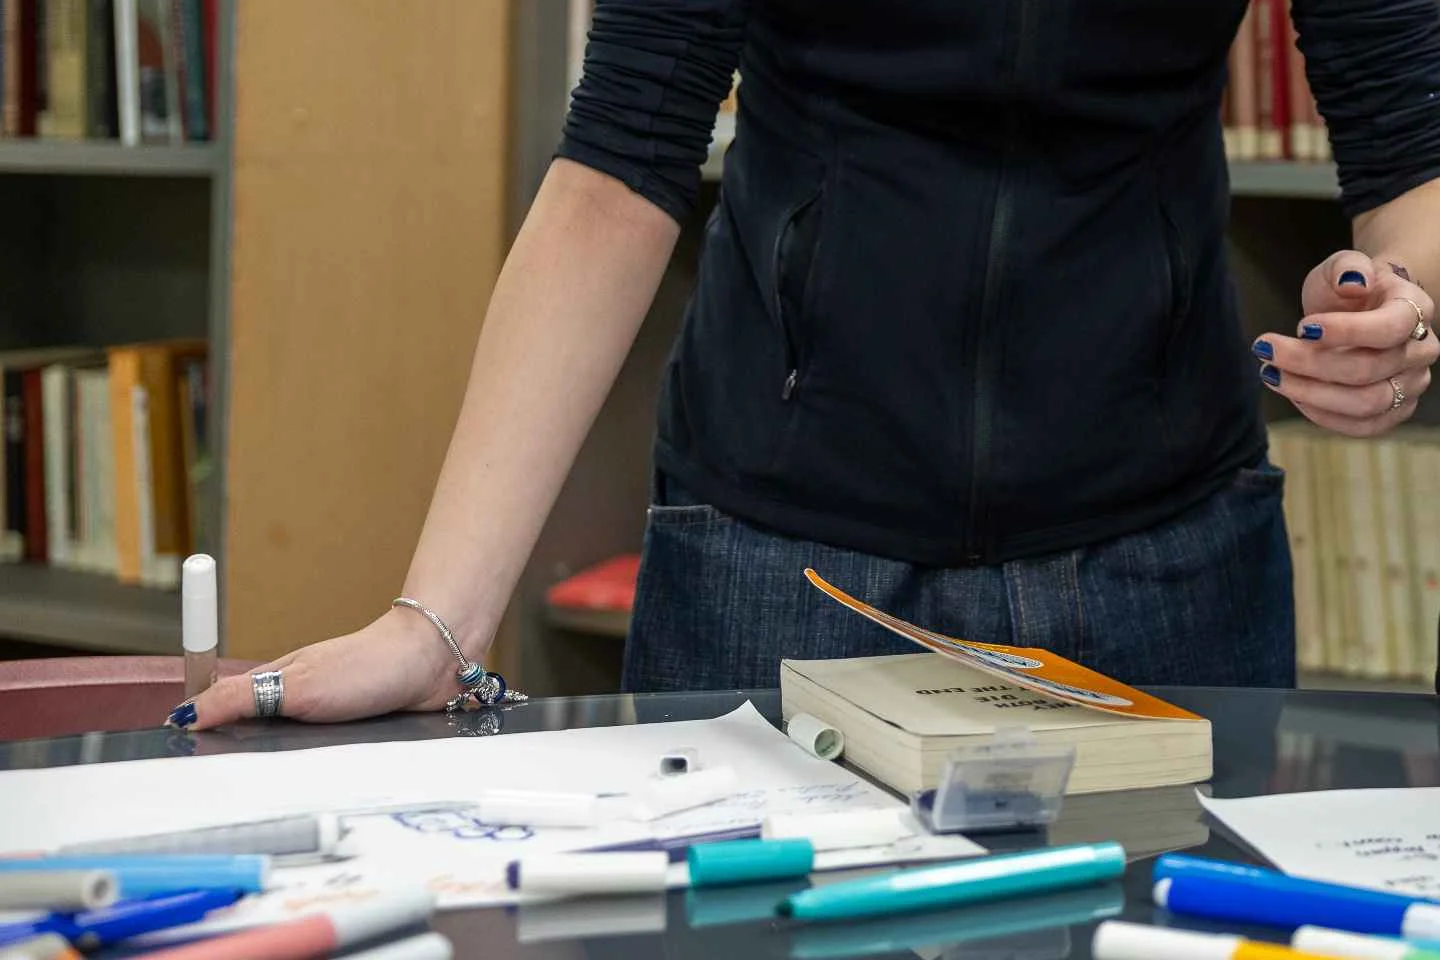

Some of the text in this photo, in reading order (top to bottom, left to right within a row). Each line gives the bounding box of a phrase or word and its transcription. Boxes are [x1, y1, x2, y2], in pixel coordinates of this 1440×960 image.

[915, 686, 965, 696] END
[971, 685, 1010, 695] THE
[974, 693, 1017, 704] DIE
